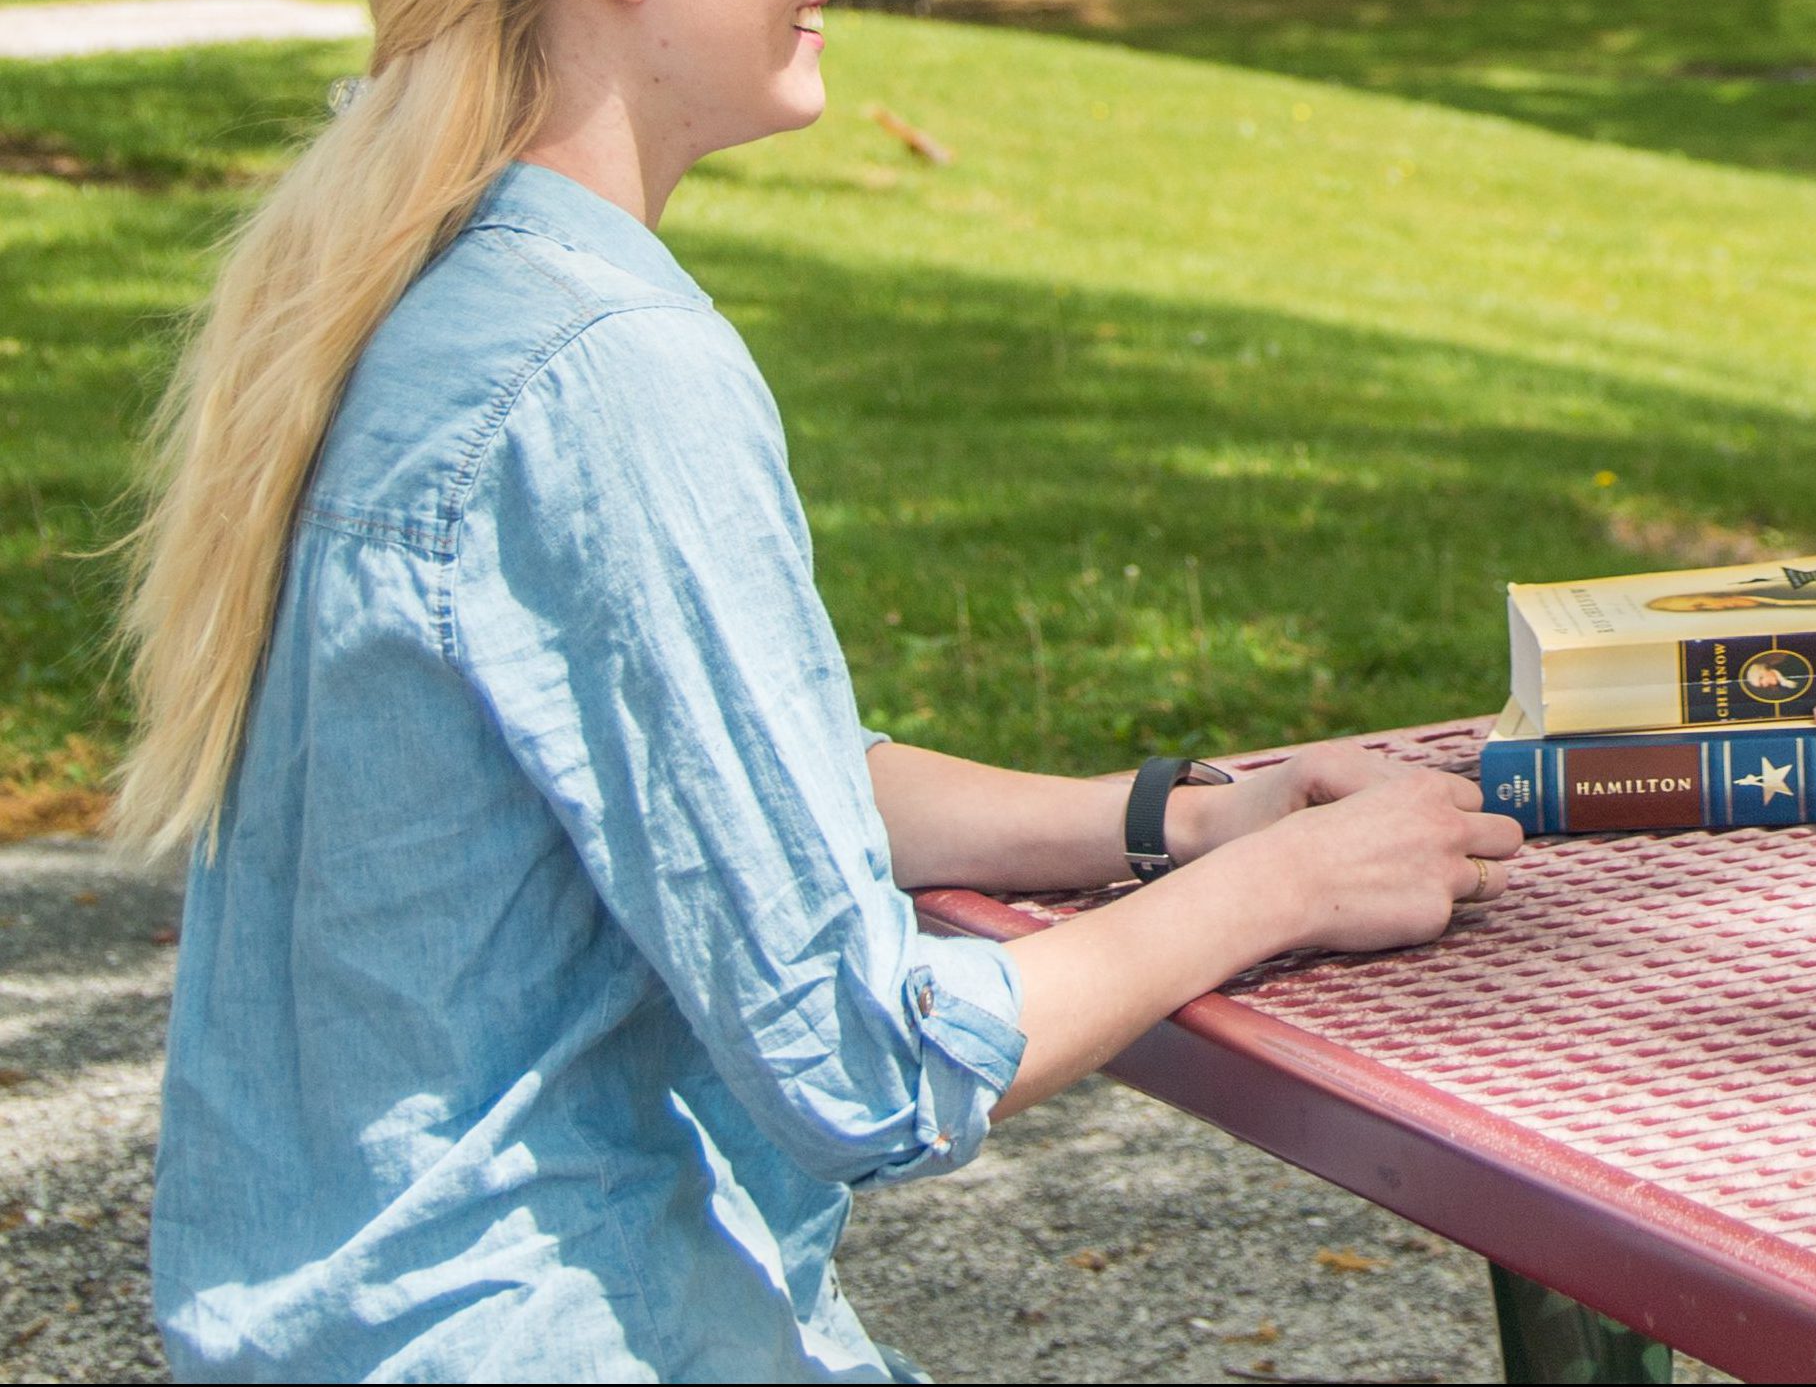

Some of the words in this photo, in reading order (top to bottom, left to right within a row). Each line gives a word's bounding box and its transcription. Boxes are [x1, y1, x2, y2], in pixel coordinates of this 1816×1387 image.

[1701, 668, 1711, 693] RON
[1714, 643, 1729, 718] CHERNOW
[1576, 778, 1692, 796] HAMILTON
